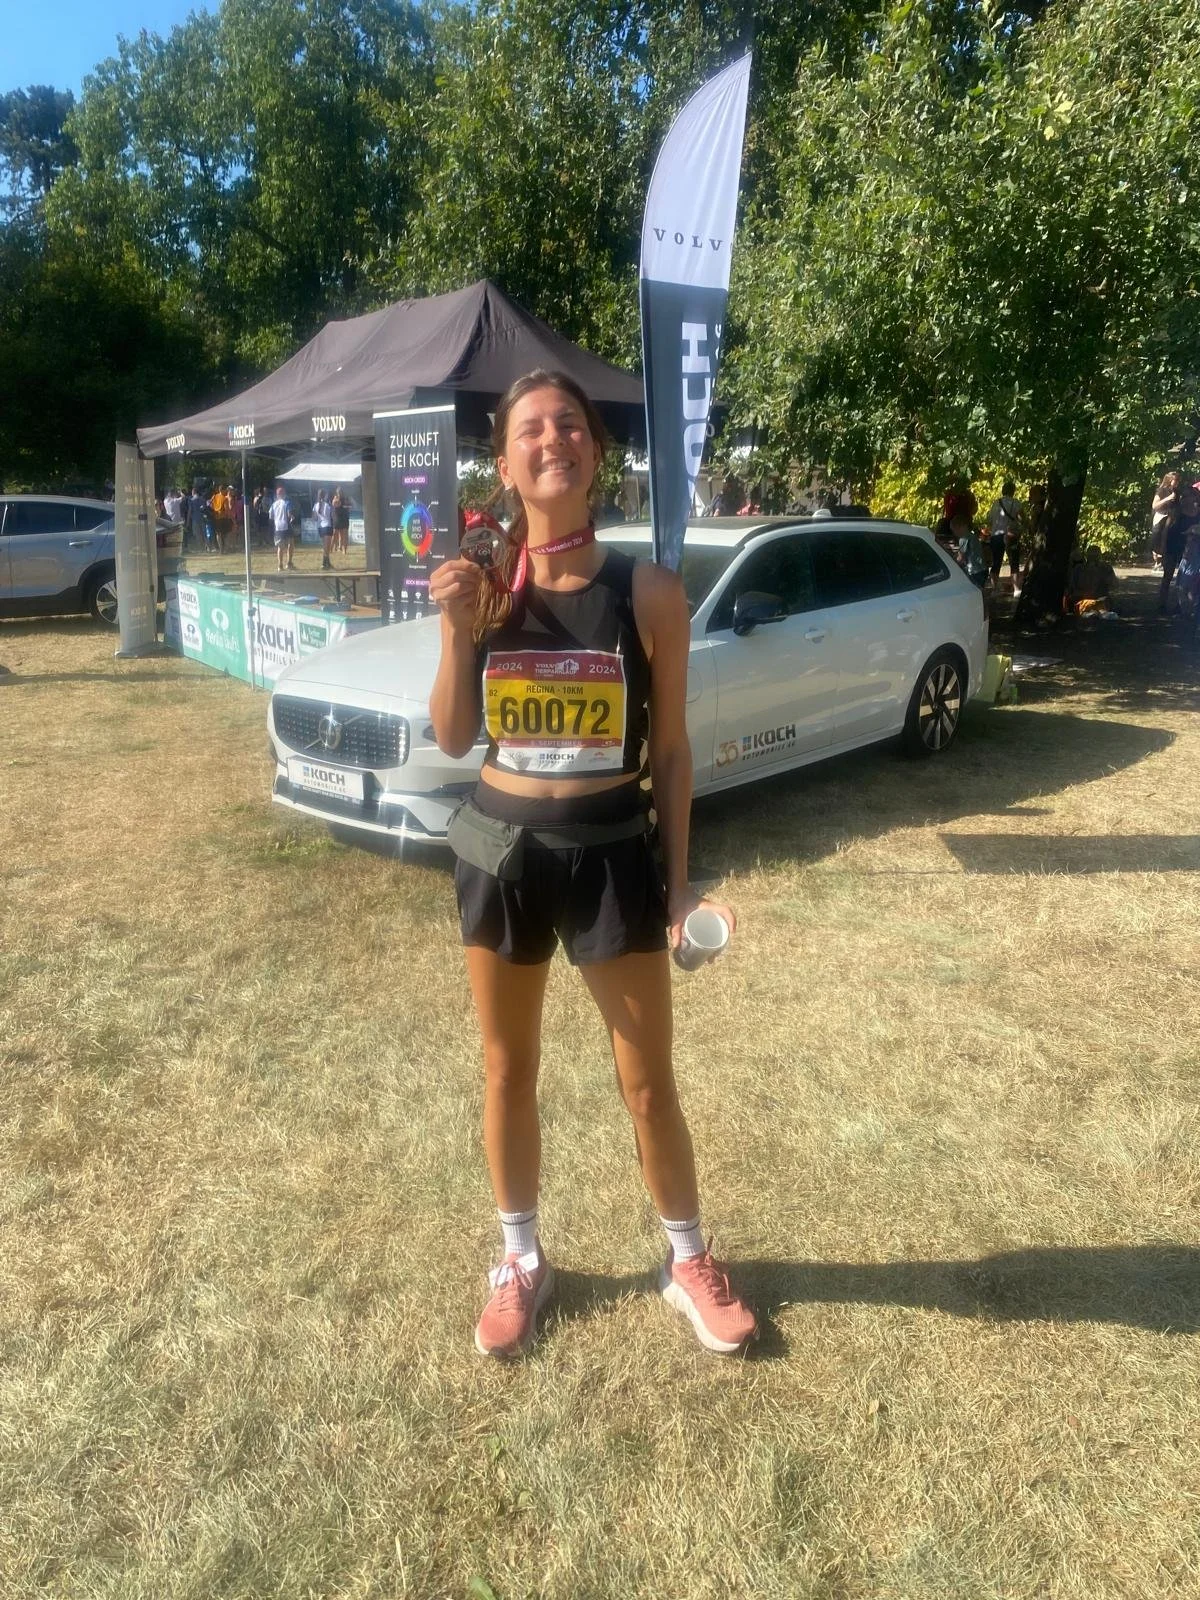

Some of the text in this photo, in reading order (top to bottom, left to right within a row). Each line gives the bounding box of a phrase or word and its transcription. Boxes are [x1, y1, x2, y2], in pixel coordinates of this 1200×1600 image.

[653, 228, 732, 251] VOLV
[233, 424, 255, 439] KOCH
[311, 415, 346, 432] VOLVO
[166, 434, 186, 450] VOLVO
[389, 432, 440, 449] ZUKUNFT
[390, 452, 440, 469] BEI KOCH
[546, 541, 572, 553] September
[256, 621, 295, 655] KOCH
[495, 662, 523, 671] 2024
[588, 664, 617, 675] 2024
[526, 685, 555, 695] REGINA
[563, 686, 584, 695] 10KM
[500, 696, 611, 736] 60072
[754, 724, 796, 749] KOCH
[310, 767, 345, 786] KOCH
